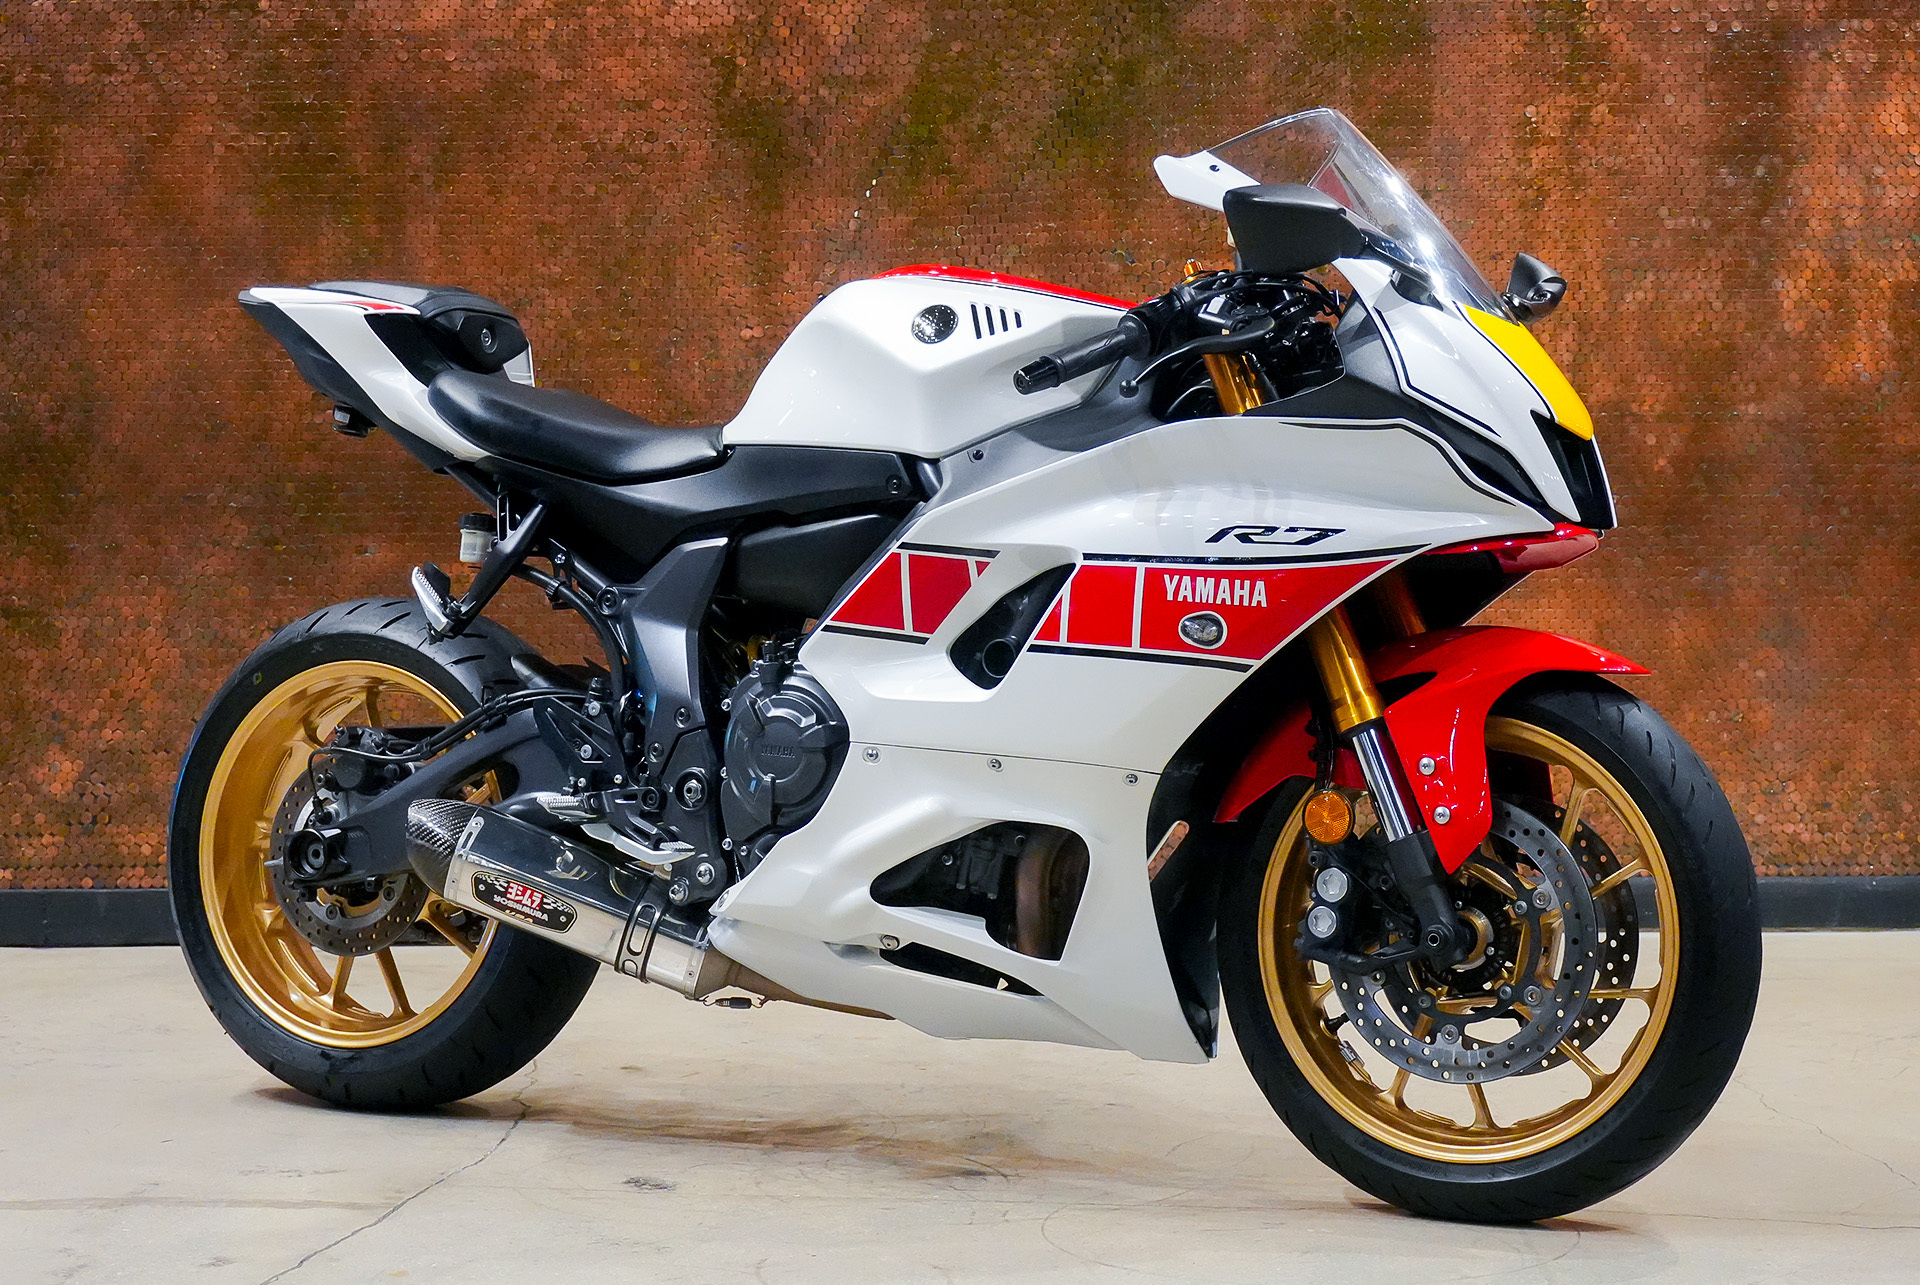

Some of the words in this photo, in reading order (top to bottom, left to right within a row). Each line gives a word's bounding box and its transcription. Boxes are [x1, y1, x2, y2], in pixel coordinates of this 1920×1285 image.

[1205, 525, 1346, 546] R7
[1163, 574, 1268, 608] YAMAHA
[493, 894, 549, 922] YOSHIMURA
